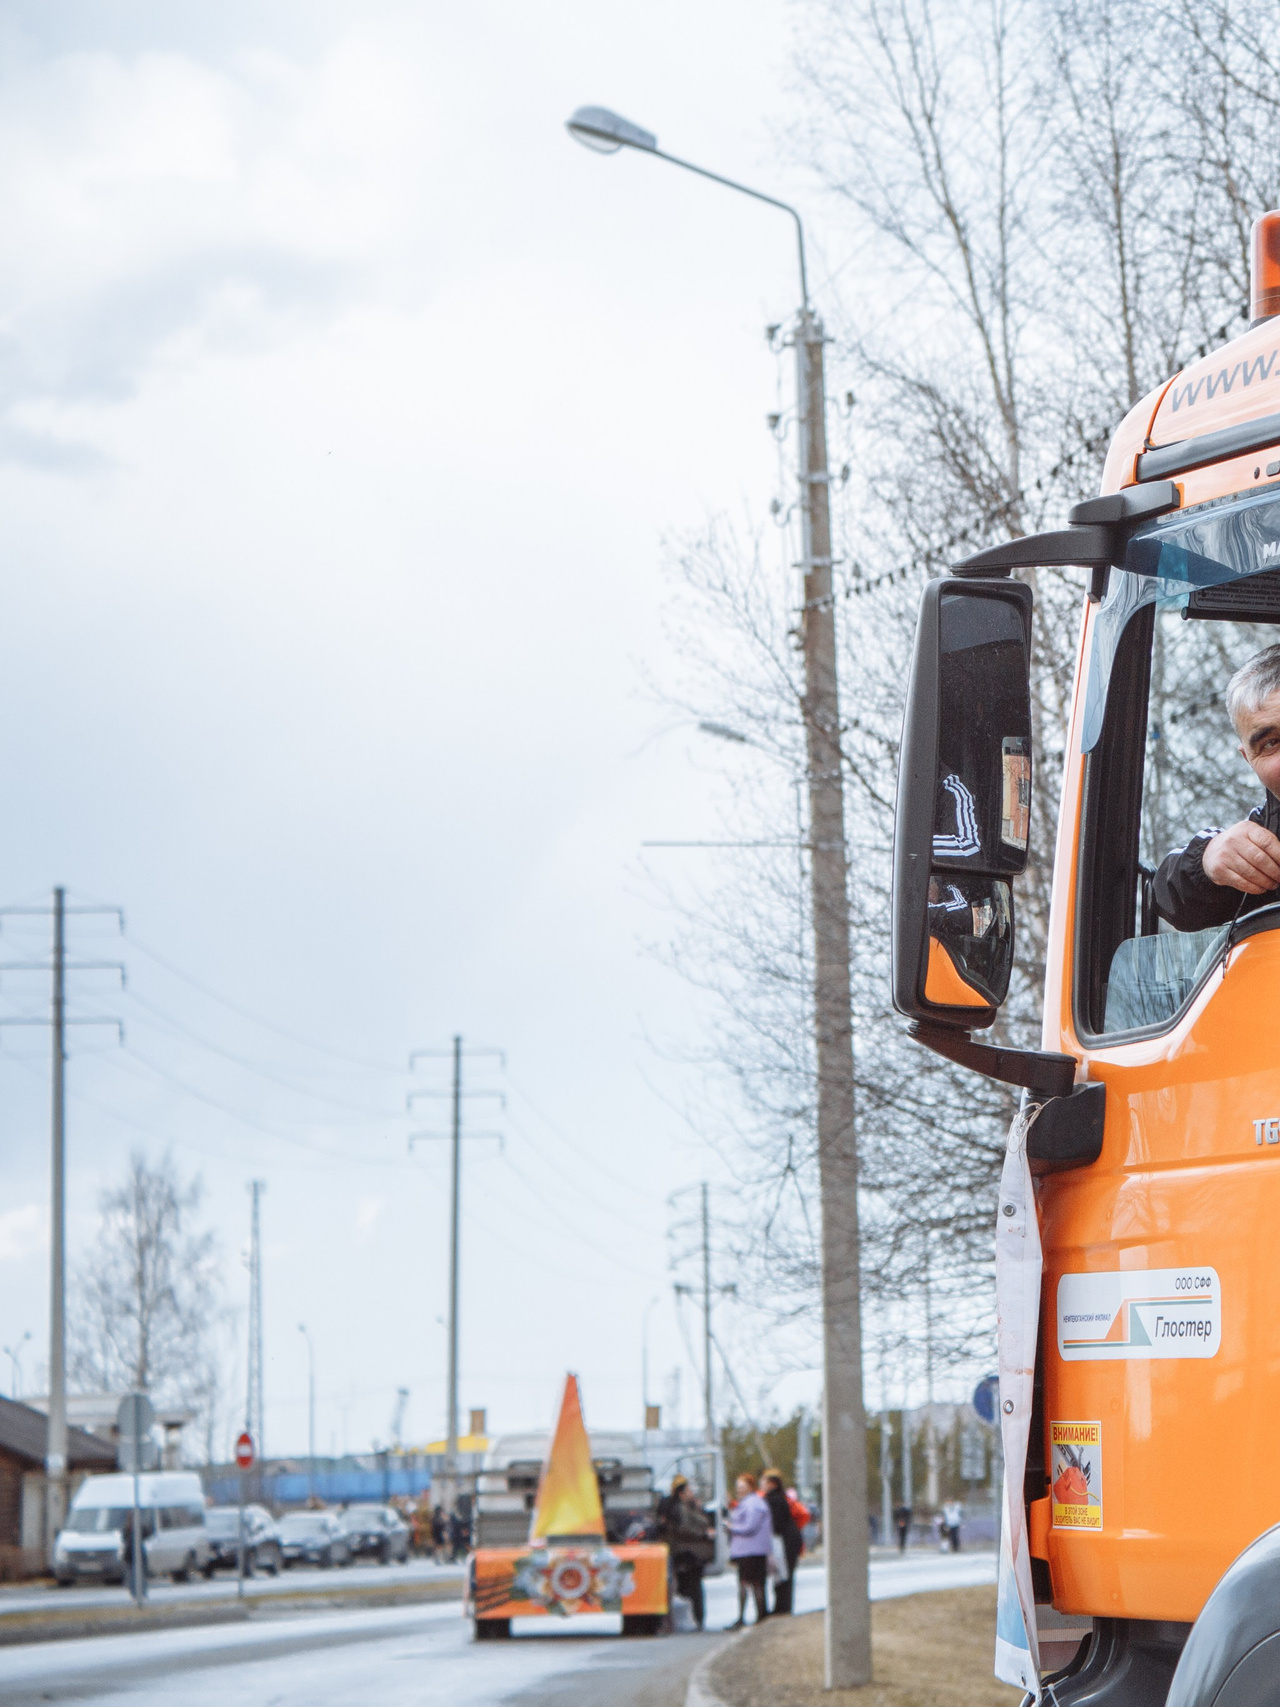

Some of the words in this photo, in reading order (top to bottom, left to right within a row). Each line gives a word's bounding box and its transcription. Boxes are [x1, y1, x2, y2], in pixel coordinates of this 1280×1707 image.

[1175, 1277, 1193, 1290] ООО
[1194, 1276, 1212, 1290] СФФ
[1155, 1316, 1212, 1343] Глостер
[1053, 1426, 1099, 1442] ВНИМАНИЕ!
